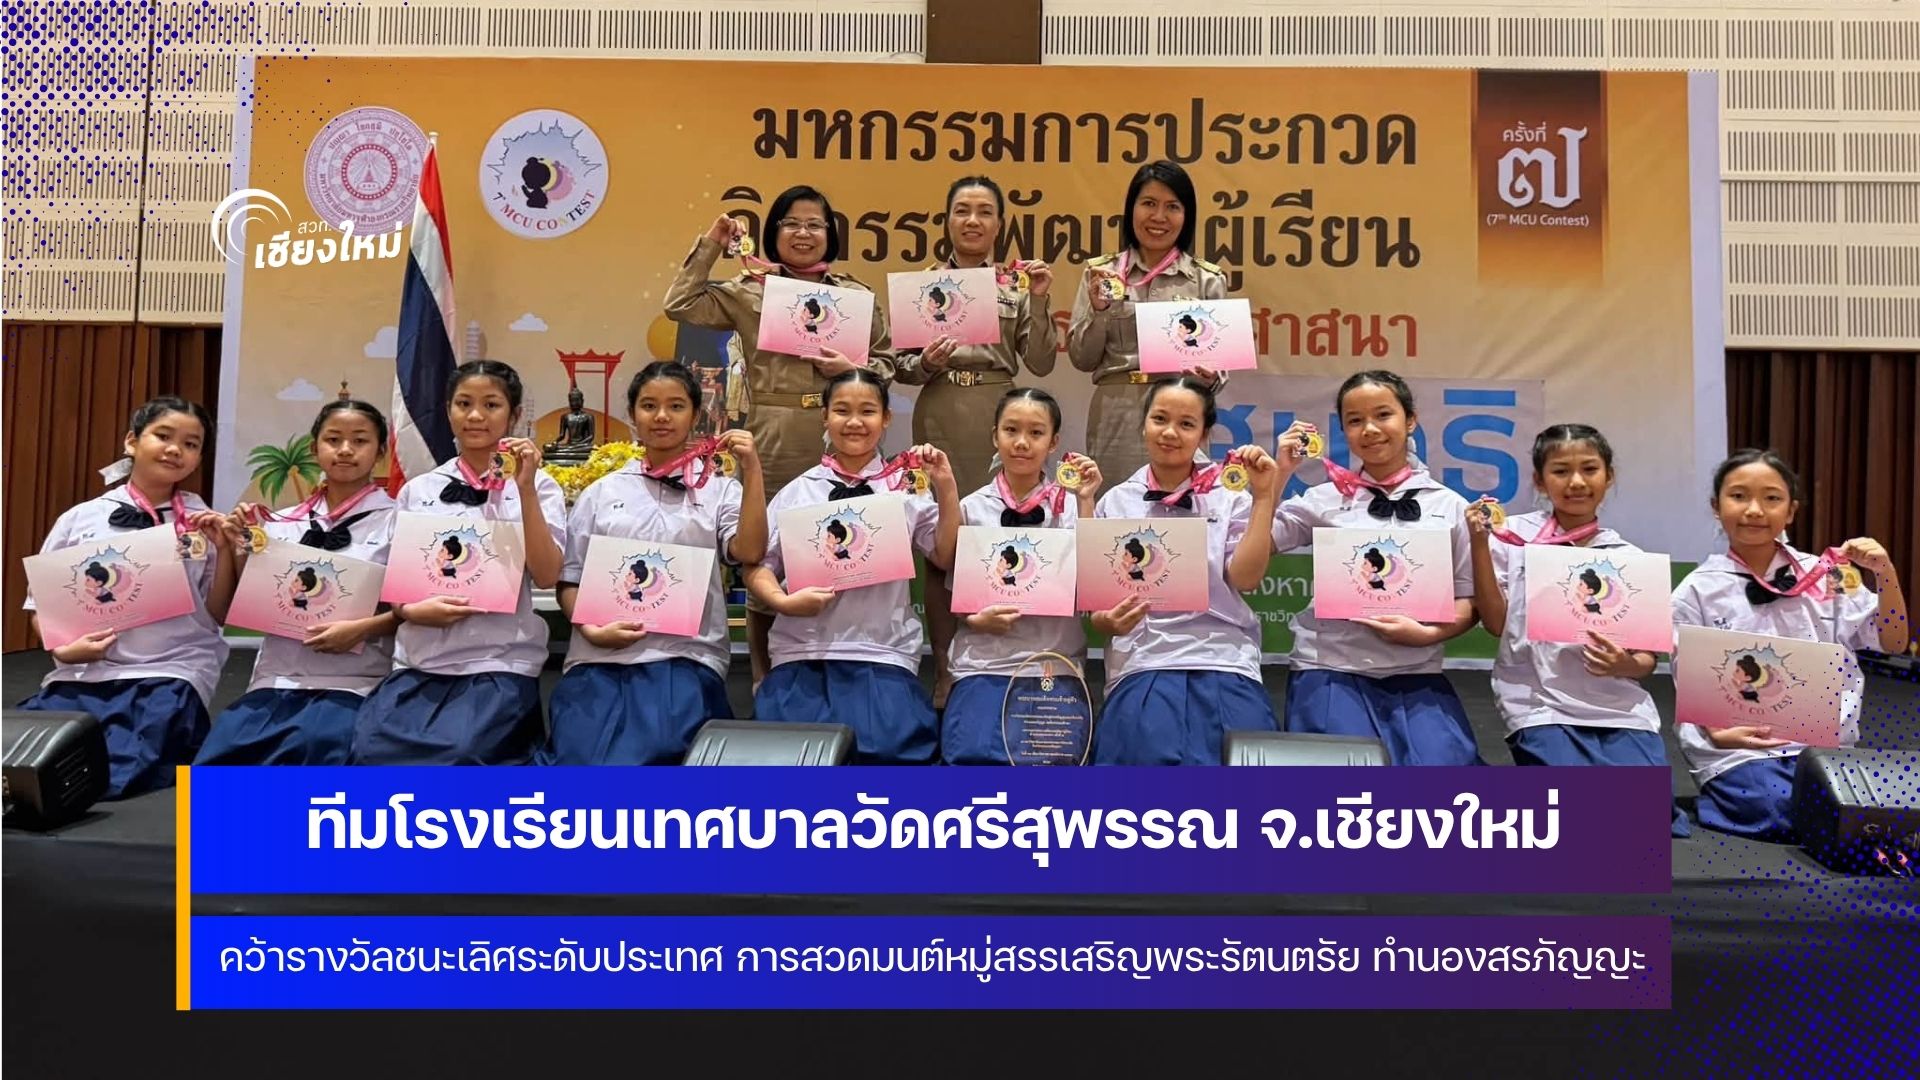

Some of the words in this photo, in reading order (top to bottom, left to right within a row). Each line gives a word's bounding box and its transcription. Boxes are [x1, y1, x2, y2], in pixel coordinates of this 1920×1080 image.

[753, 98, 1416, 165] มหกรรมการประกวด
[1503, 120, 1547, 142] ครั้งที่
[1497, 126, 1588, 208] ๗
[500, 203, 533, 228] MCU
[1509, 213, 1537, 226] MCU
[1540, 213, 1590, 227] Contest)
[446, 569, 485, 590] COTEST
[632, 593, 669, 612] COTEST
[1592, 604, 1631, 626] COTEST
[1749, 695, 1793, 715] COTEST
